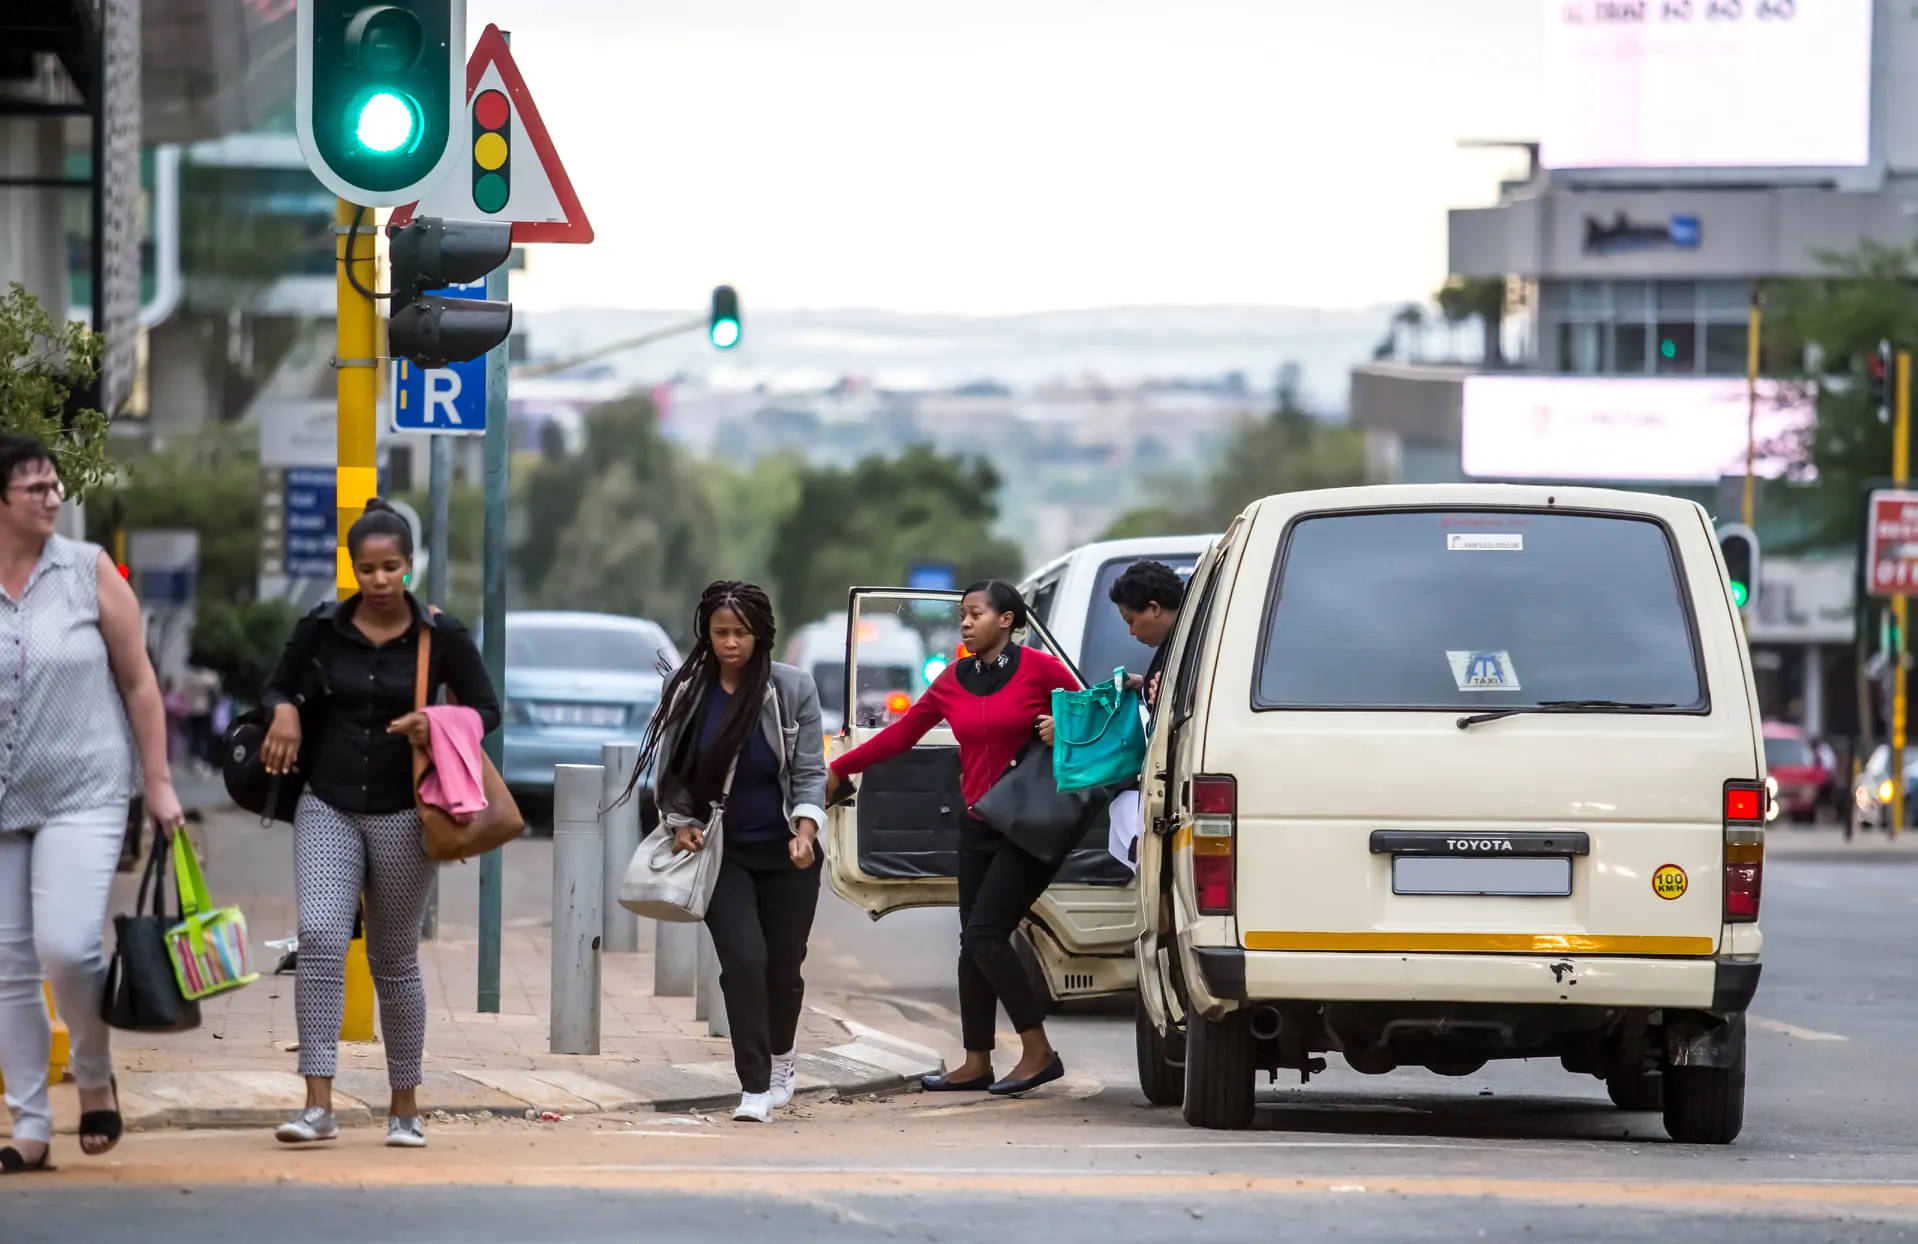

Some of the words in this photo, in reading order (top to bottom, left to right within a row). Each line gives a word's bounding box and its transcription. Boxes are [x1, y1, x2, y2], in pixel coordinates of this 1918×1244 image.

[423, 368, 462, 424] R
[1446, 840, 1513, 850] TOYOTA
[1656, 873, 1683, 885] 100
